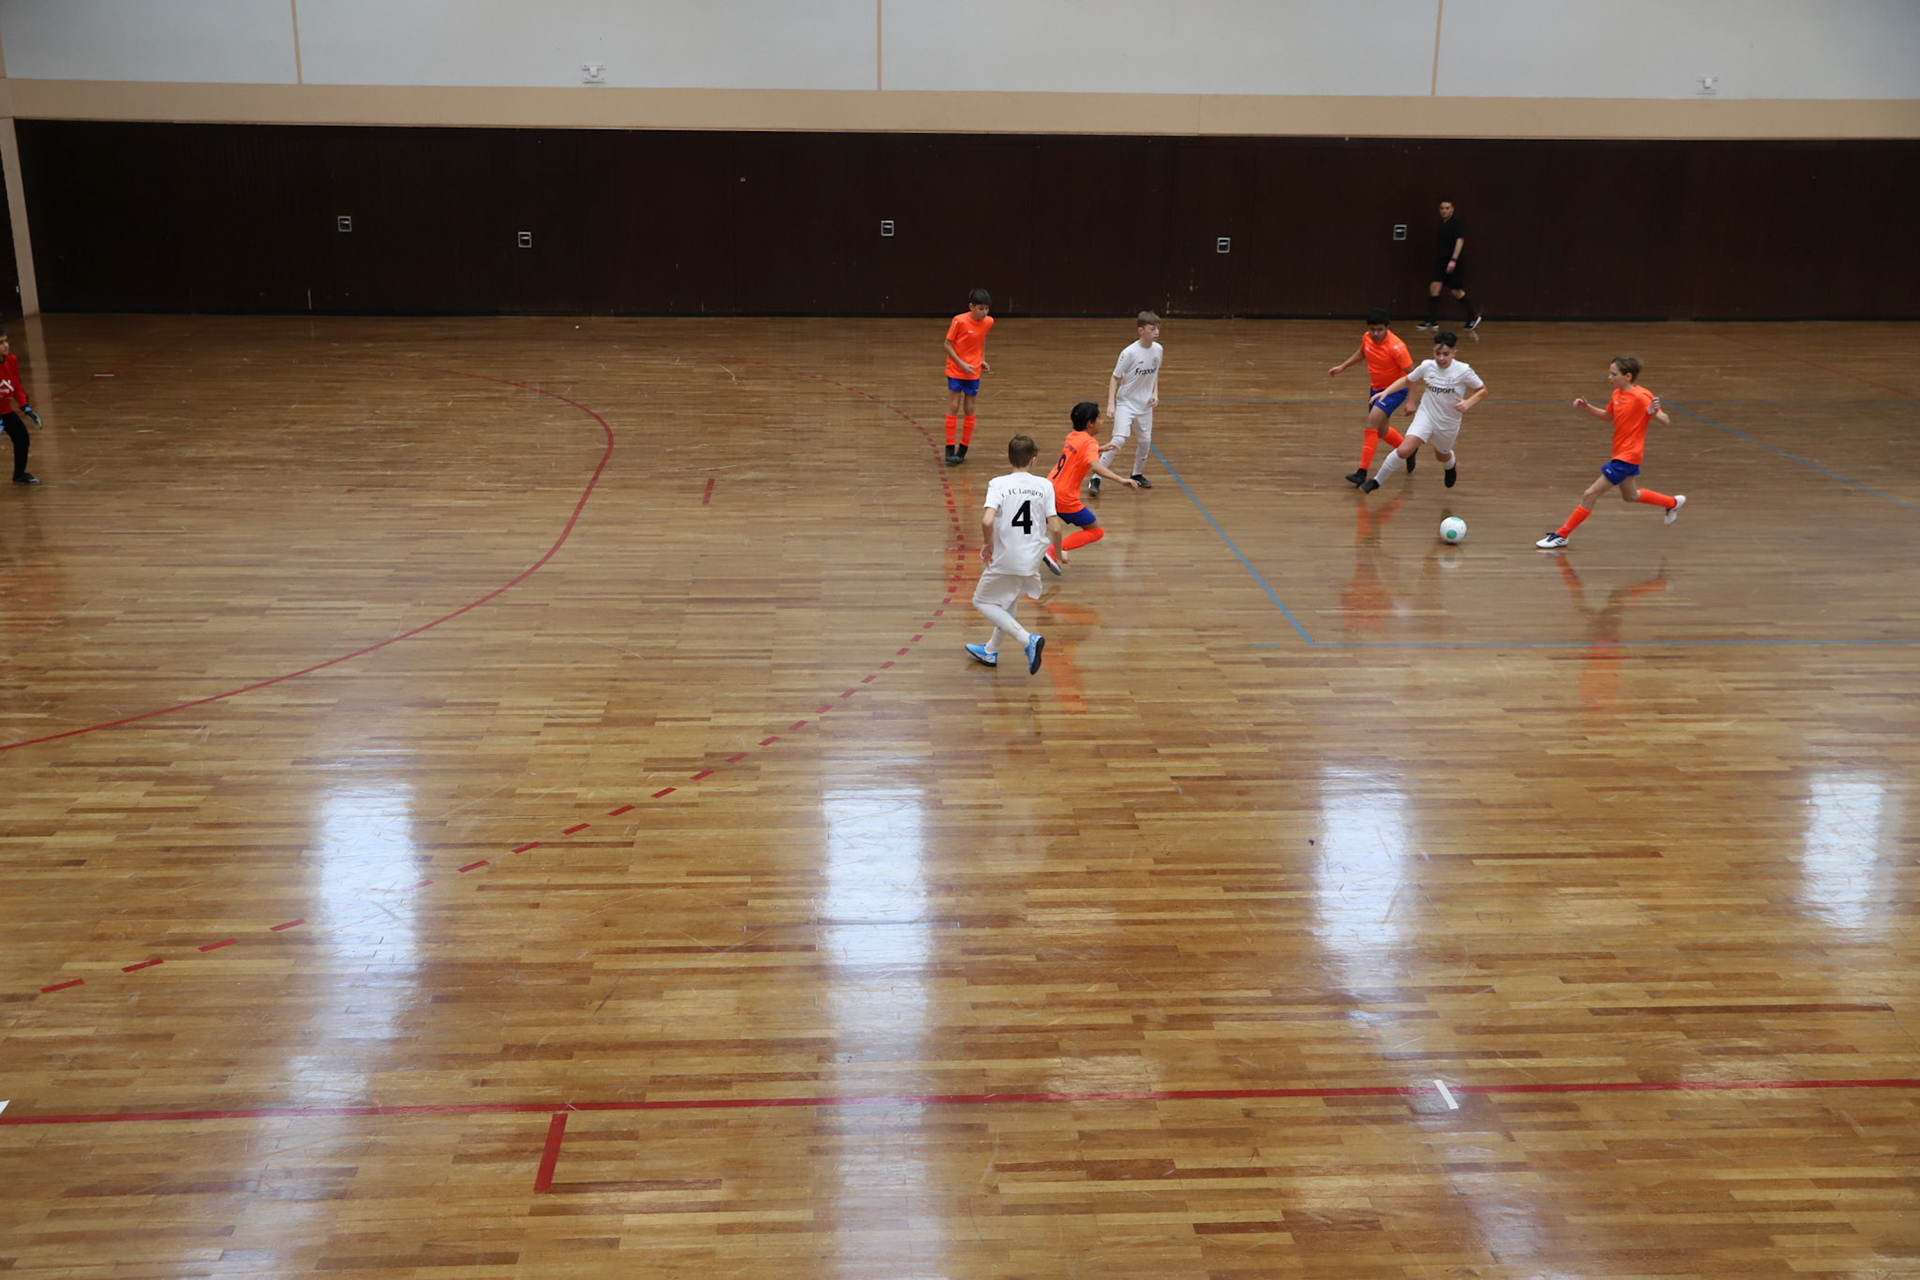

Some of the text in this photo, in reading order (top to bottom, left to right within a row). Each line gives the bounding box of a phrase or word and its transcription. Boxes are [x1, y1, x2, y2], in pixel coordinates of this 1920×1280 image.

[1052, 453, 1066, 479] 9
[1008, 487, 1017, 496] FC
[1019, 488, 1043, 498] Langen
[1011, 499, 1033, 534] 4
